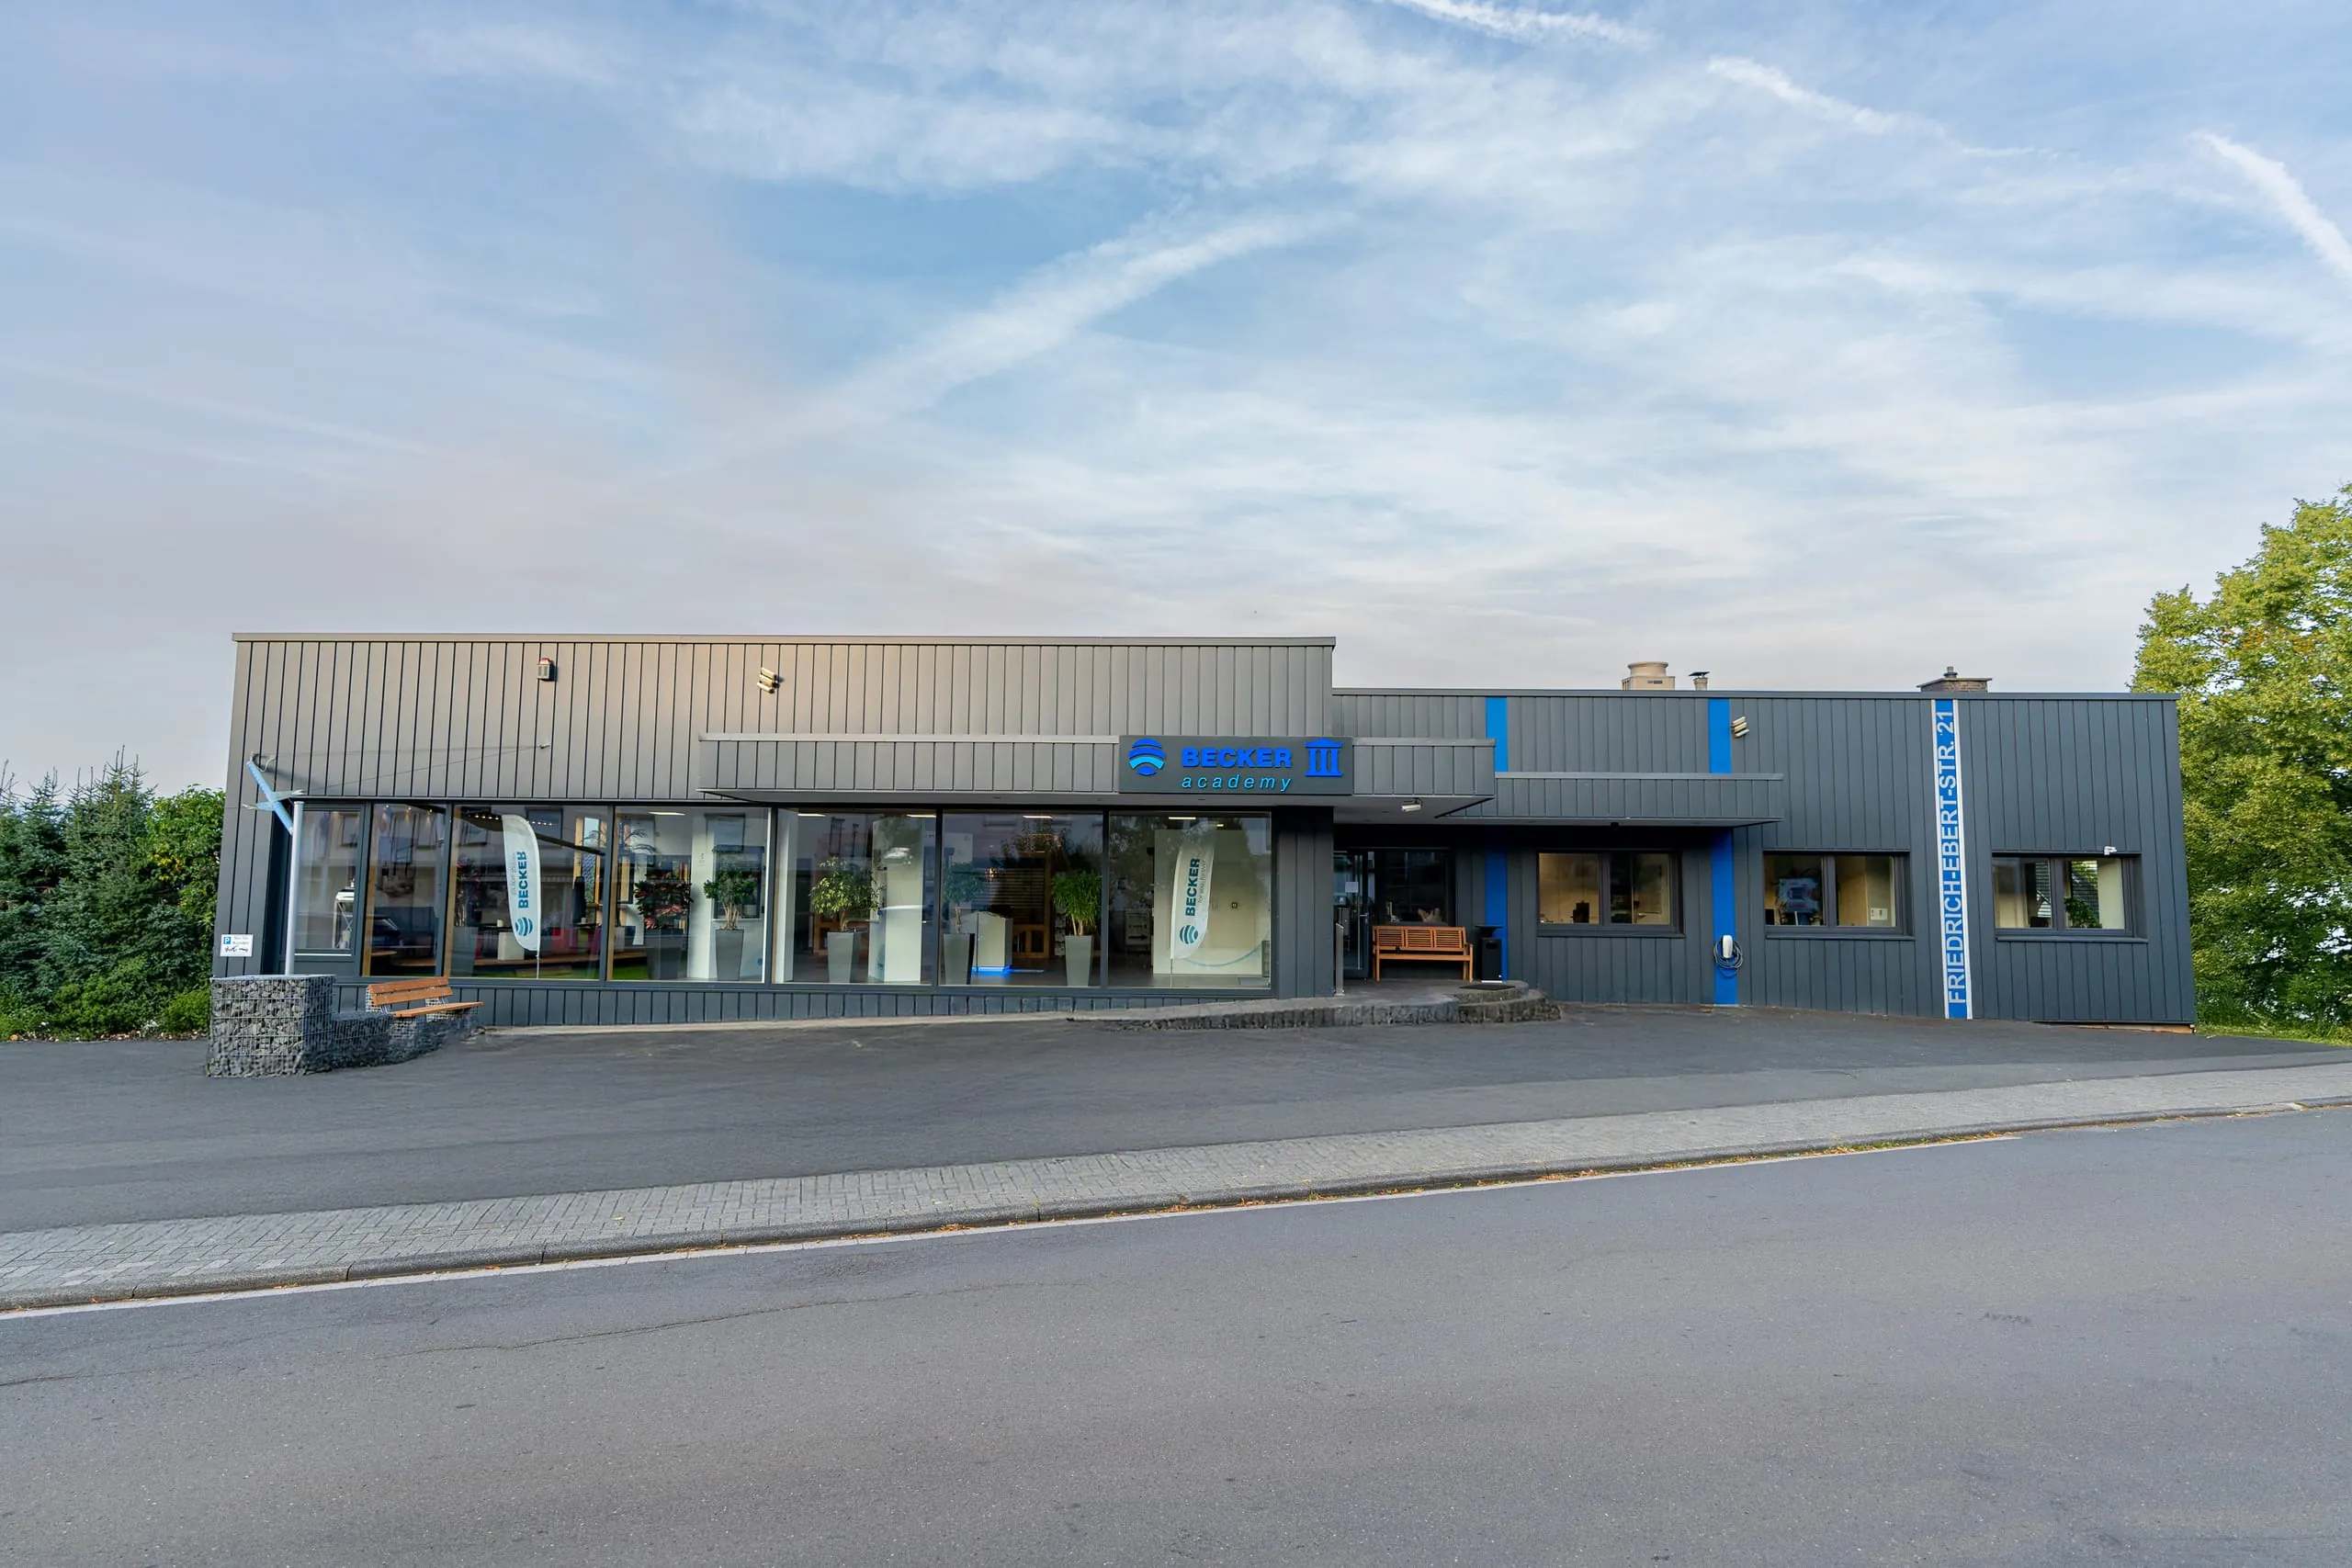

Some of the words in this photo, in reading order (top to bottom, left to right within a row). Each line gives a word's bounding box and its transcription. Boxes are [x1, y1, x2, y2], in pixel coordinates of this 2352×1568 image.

[1936, 712, 1954, 733] 21
[1182, 748, 1293, 768] BECKER
[1182, 774, 1293, 793] academy
[1938, 740, 1965, 1003] FRIEDRICH-EBERT-STR.
[1185, 858, 1200, 916] BECKER
